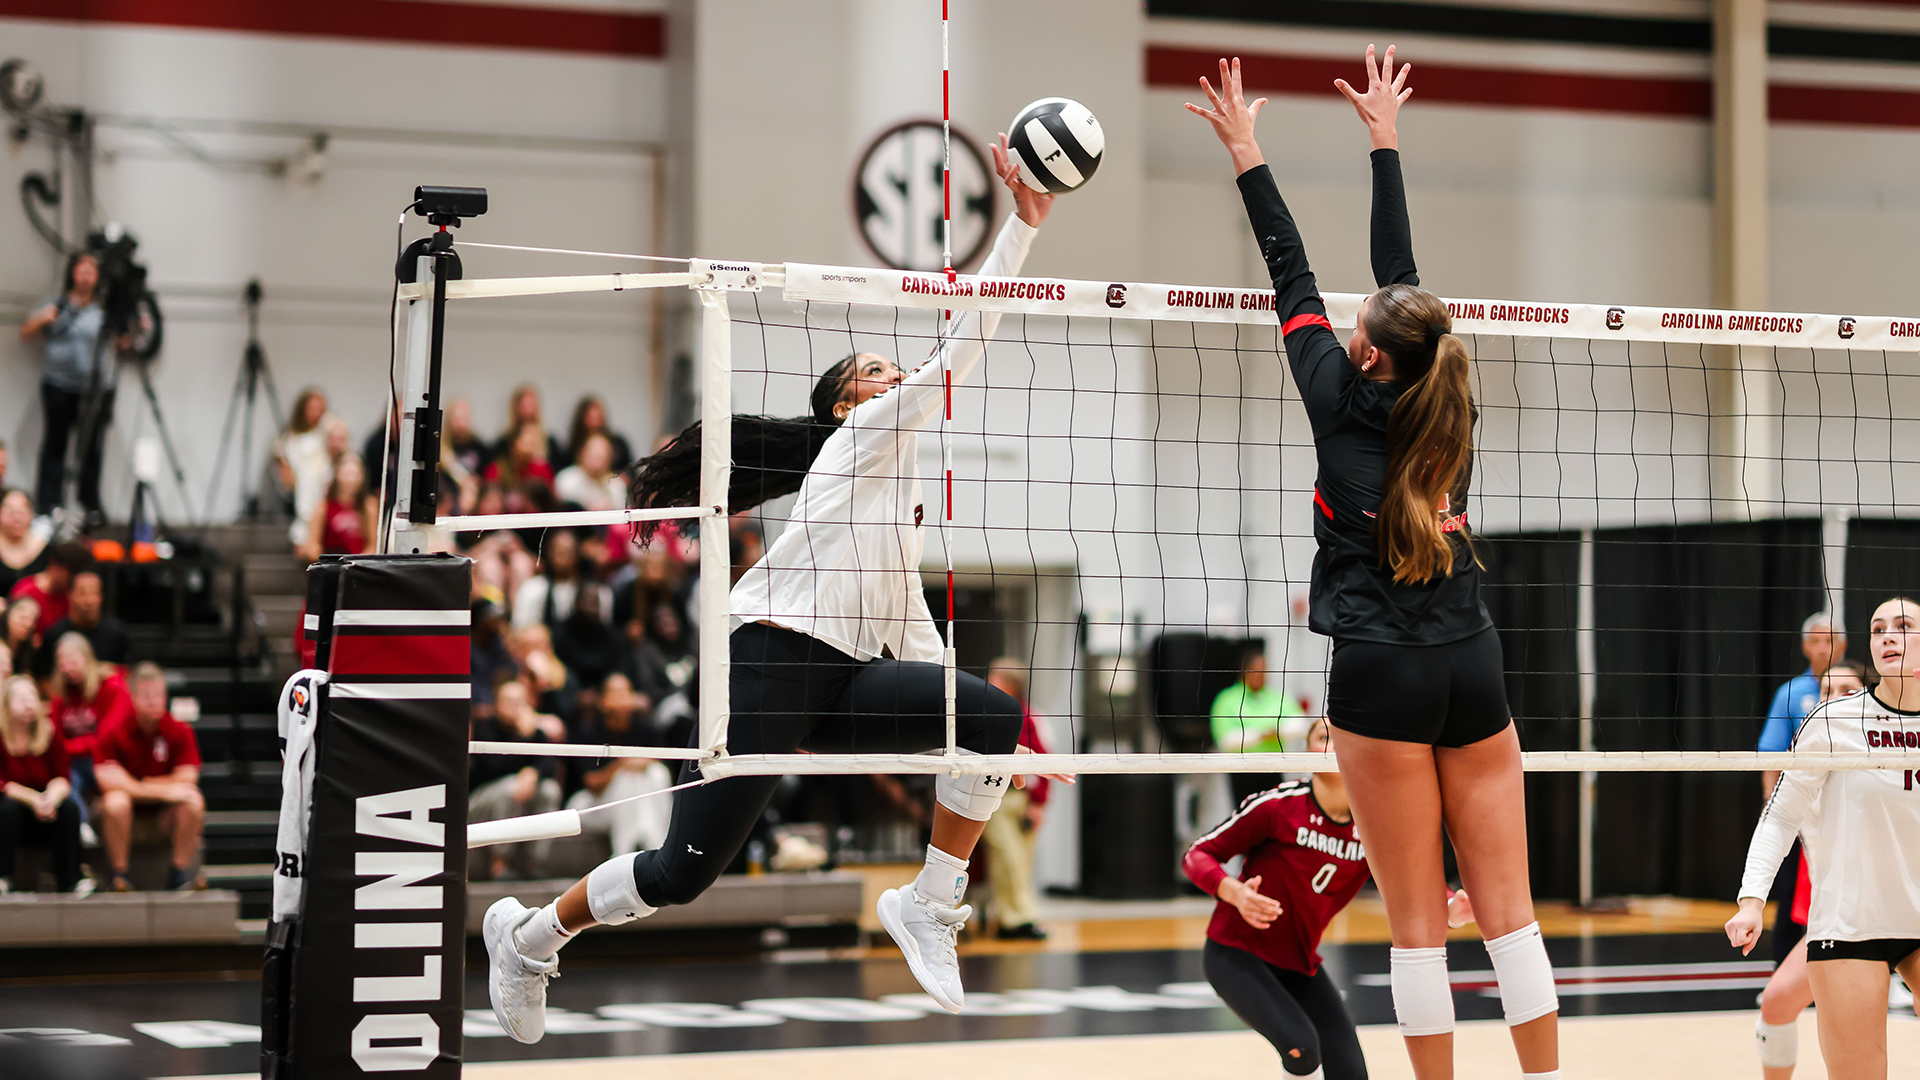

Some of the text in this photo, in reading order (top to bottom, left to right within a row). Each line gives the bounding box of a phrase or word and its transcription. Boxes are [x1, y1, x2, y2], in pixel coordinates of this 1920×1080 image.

[860, 124, 988, 272] SEC
[716, 263, 751, 273] Senoh
[821, 273, 868, 285] sports imports
[901, 275, 1067, 302] CAROLINA GAMECOCKS
[1166, 289, 1235, 309] CAROLINA
[1448, 302, 1570, 325] OLINA GAMECOCKS
[1660, 312, 1804, 334] CAROLINA GAMECOCKS
[1903, 769, 1920, 792] 1
[1311, 862, 1338, 894] 0
